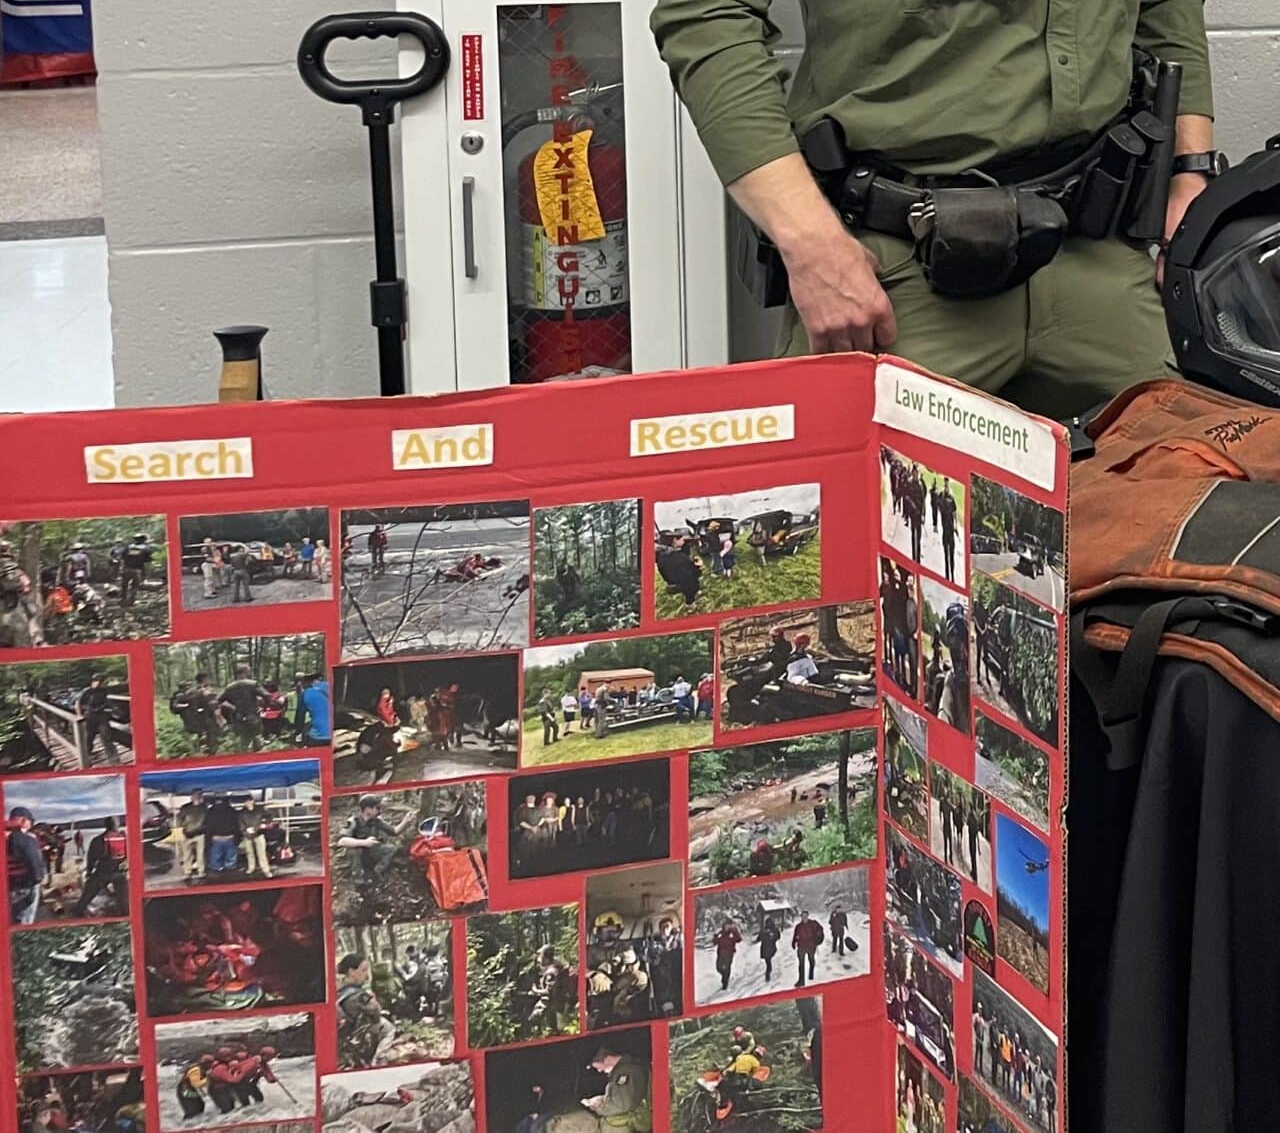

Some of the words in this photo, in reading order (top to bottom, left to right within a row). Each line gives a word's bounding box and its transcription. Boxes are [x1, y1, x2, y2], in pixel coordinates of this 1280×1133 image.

[93, 441, 244, 480] Search
[399, 426, 488, 465] And
[636, 410, 779, 453] Rescue
[894, 378, 924, 412] Law
[928, 391, 1030, 454] Enforcement
